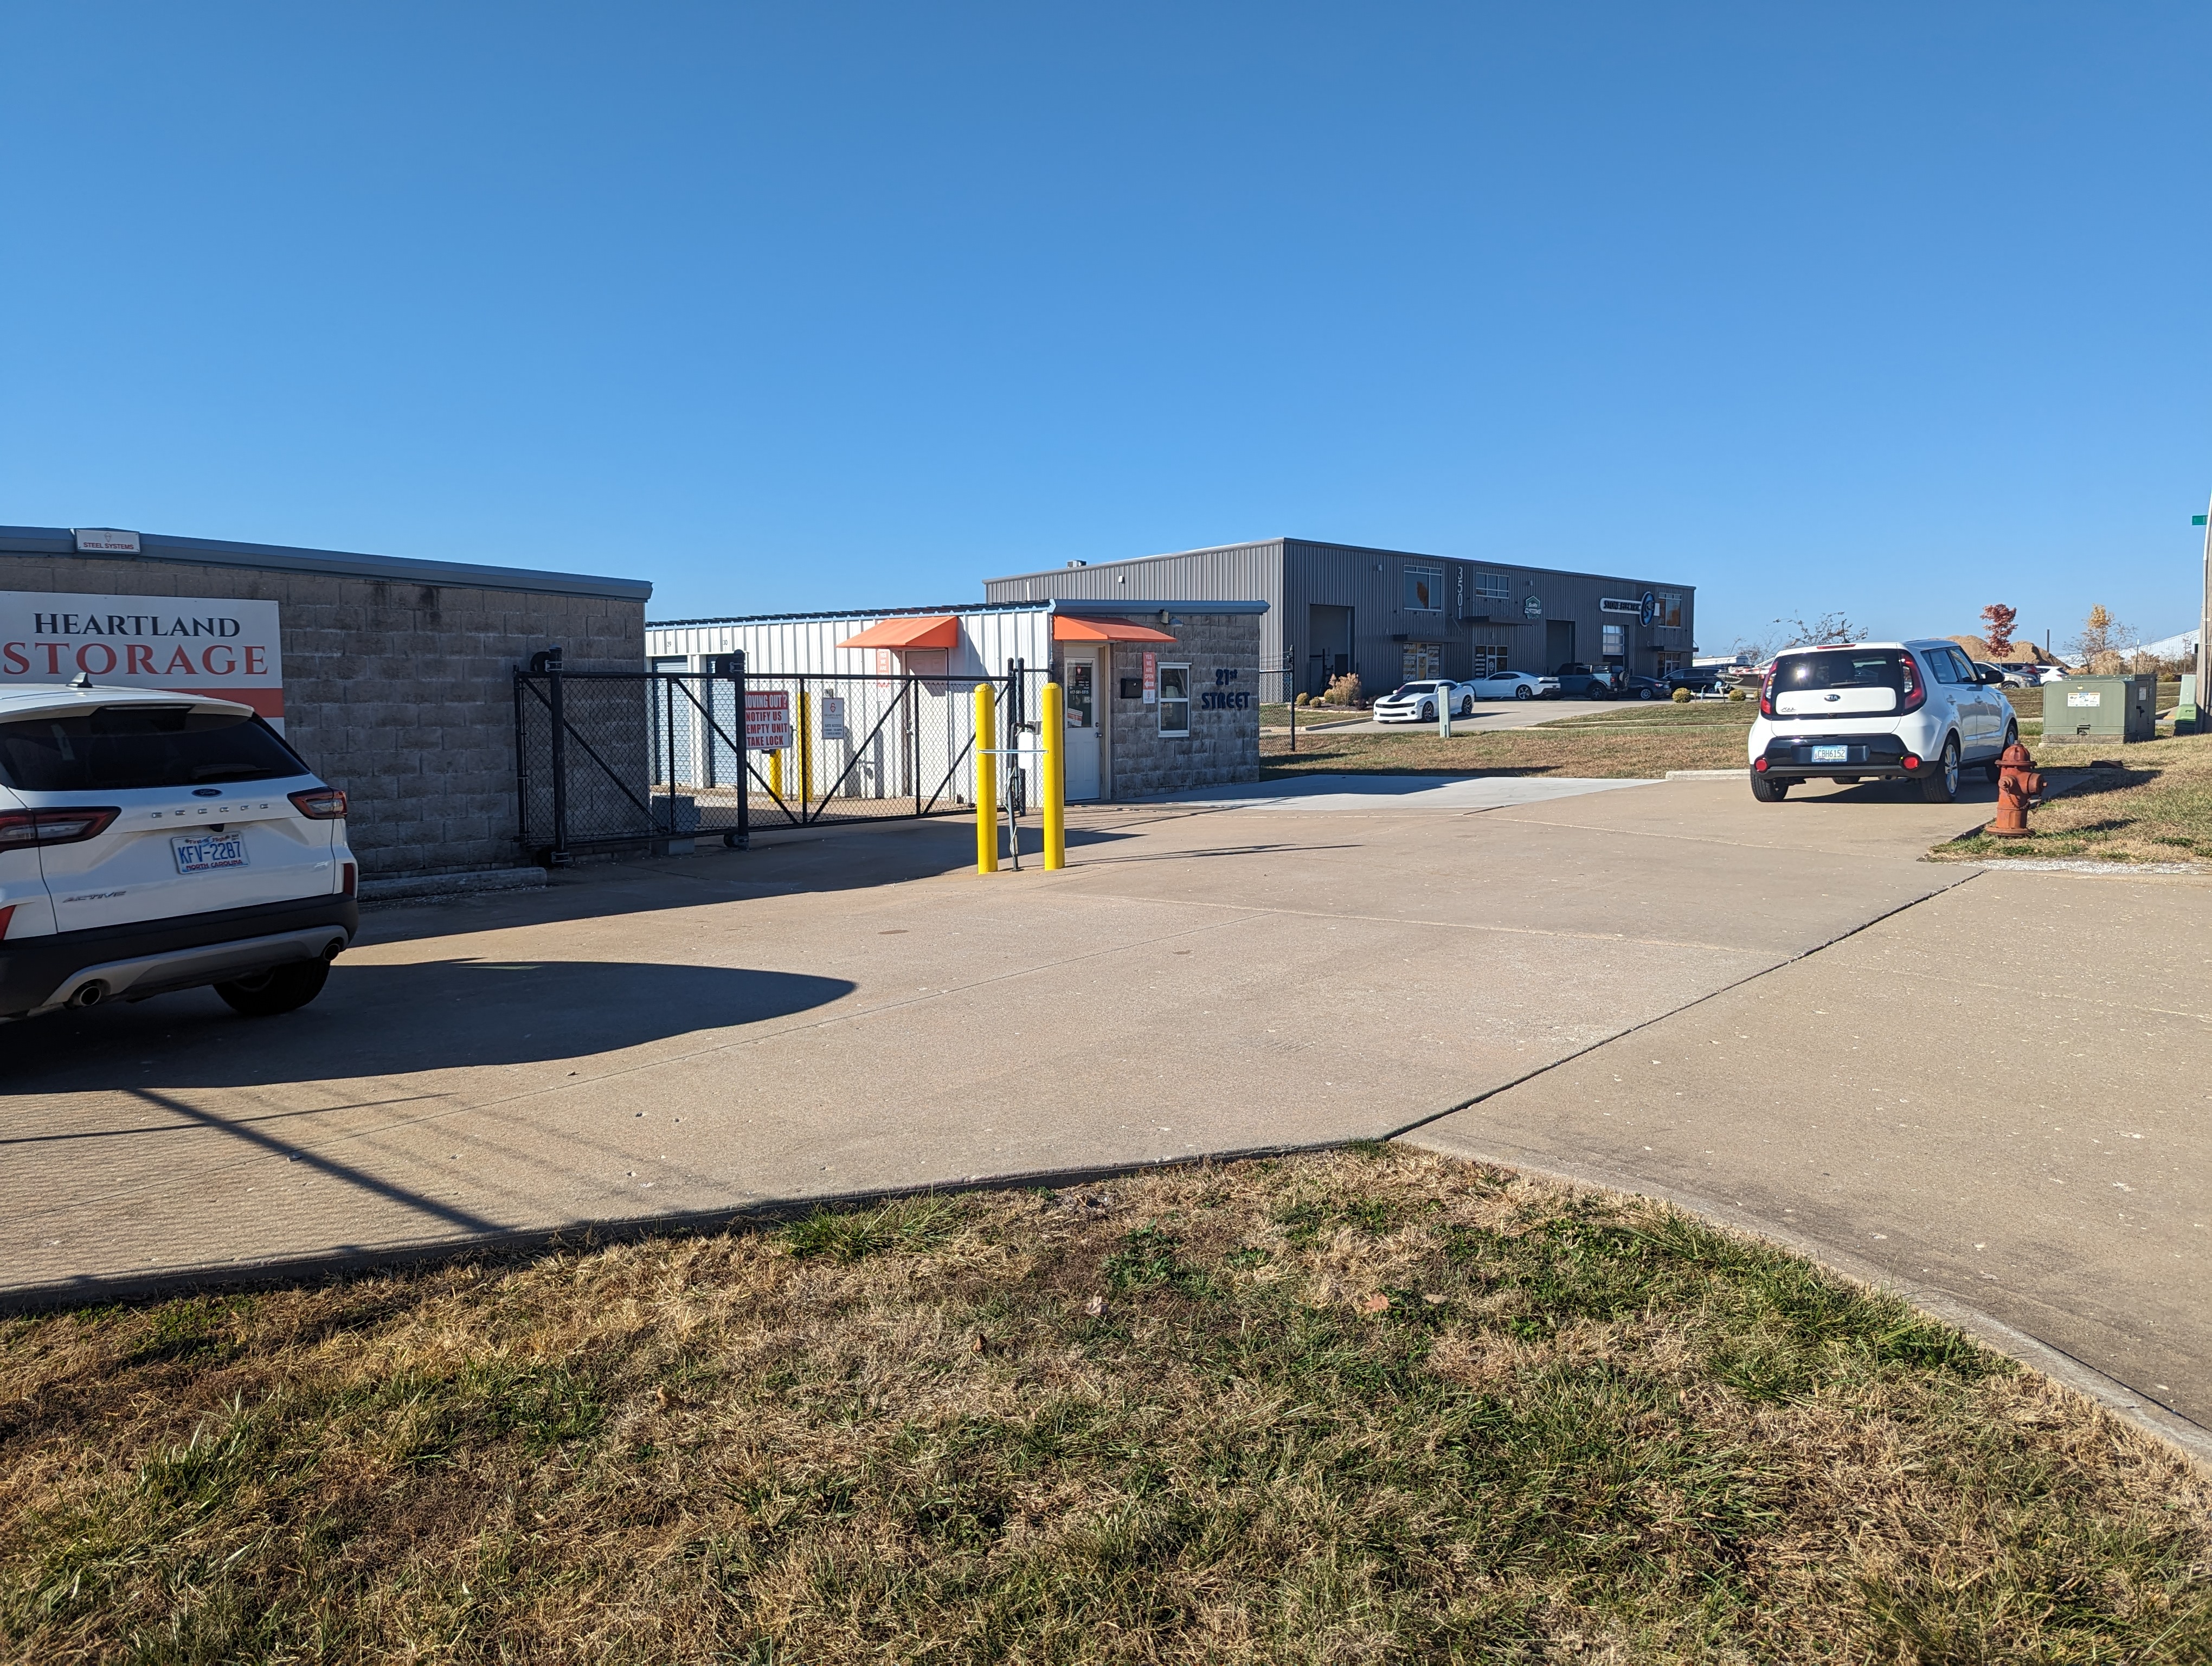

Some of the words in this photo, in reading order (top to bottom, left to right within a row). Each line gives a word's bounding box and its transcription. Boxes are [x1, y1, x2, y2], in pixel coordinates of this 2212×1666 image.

[33, 613, 241, 637] HEARTLAND
[3, 642, 268, 675] STORAGE
[1216, 669, 1238, 685] 21st
[1201, 692, 1250, 709] STREET
[746, 712, 770, 722] NOTIFY
[773, 711, 782, 721] US
[747, 723, 769, 734] EMPTY
[771, 723, 787, 733] UNIT
[747, 736, 764, 746] TAKE
[766, 735, 783, 746] LOCK
[1818, 749, 1845, 758] CBH6152
[152, 803, 269, 818] ESCAPE
[178, 841, 241, 864] KFV-2287
[62, 891, 126, 903] ACTIVE
